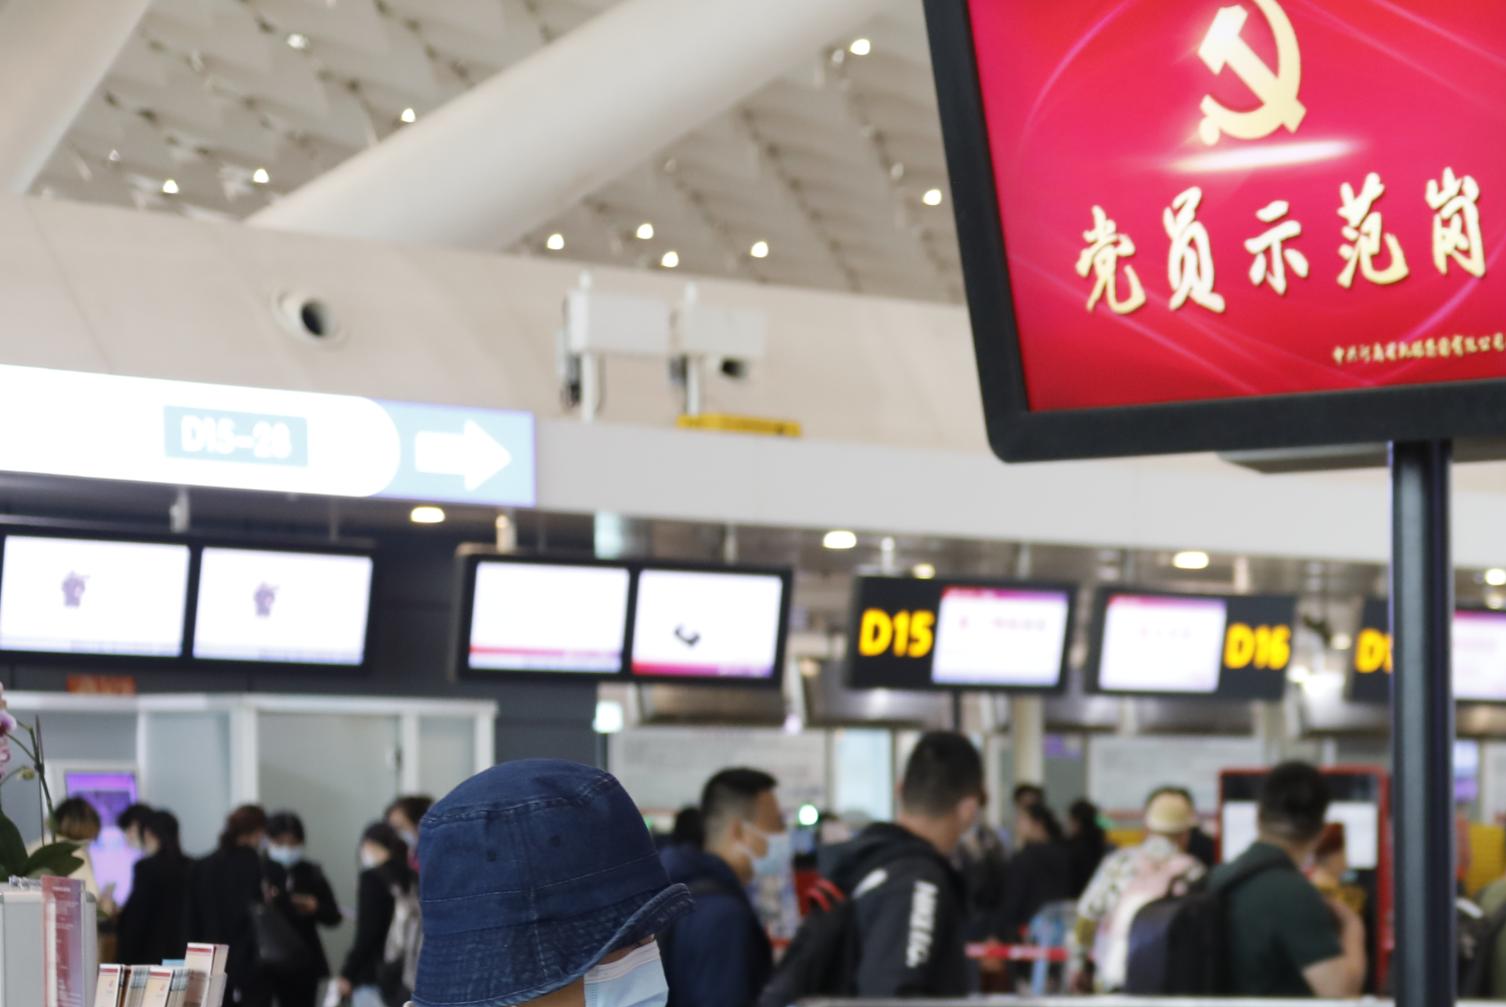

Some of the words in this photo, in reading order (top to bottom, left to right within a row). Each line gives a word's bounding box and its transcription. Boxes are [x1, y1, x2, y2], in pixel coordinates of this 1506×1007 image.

[1074, 167, 1488, 314] 党员示范岗
[858, 608, 935, 658] D15
[1223, 623, 1292, 670] D16
[1355, 628, 1393, 673] D1
